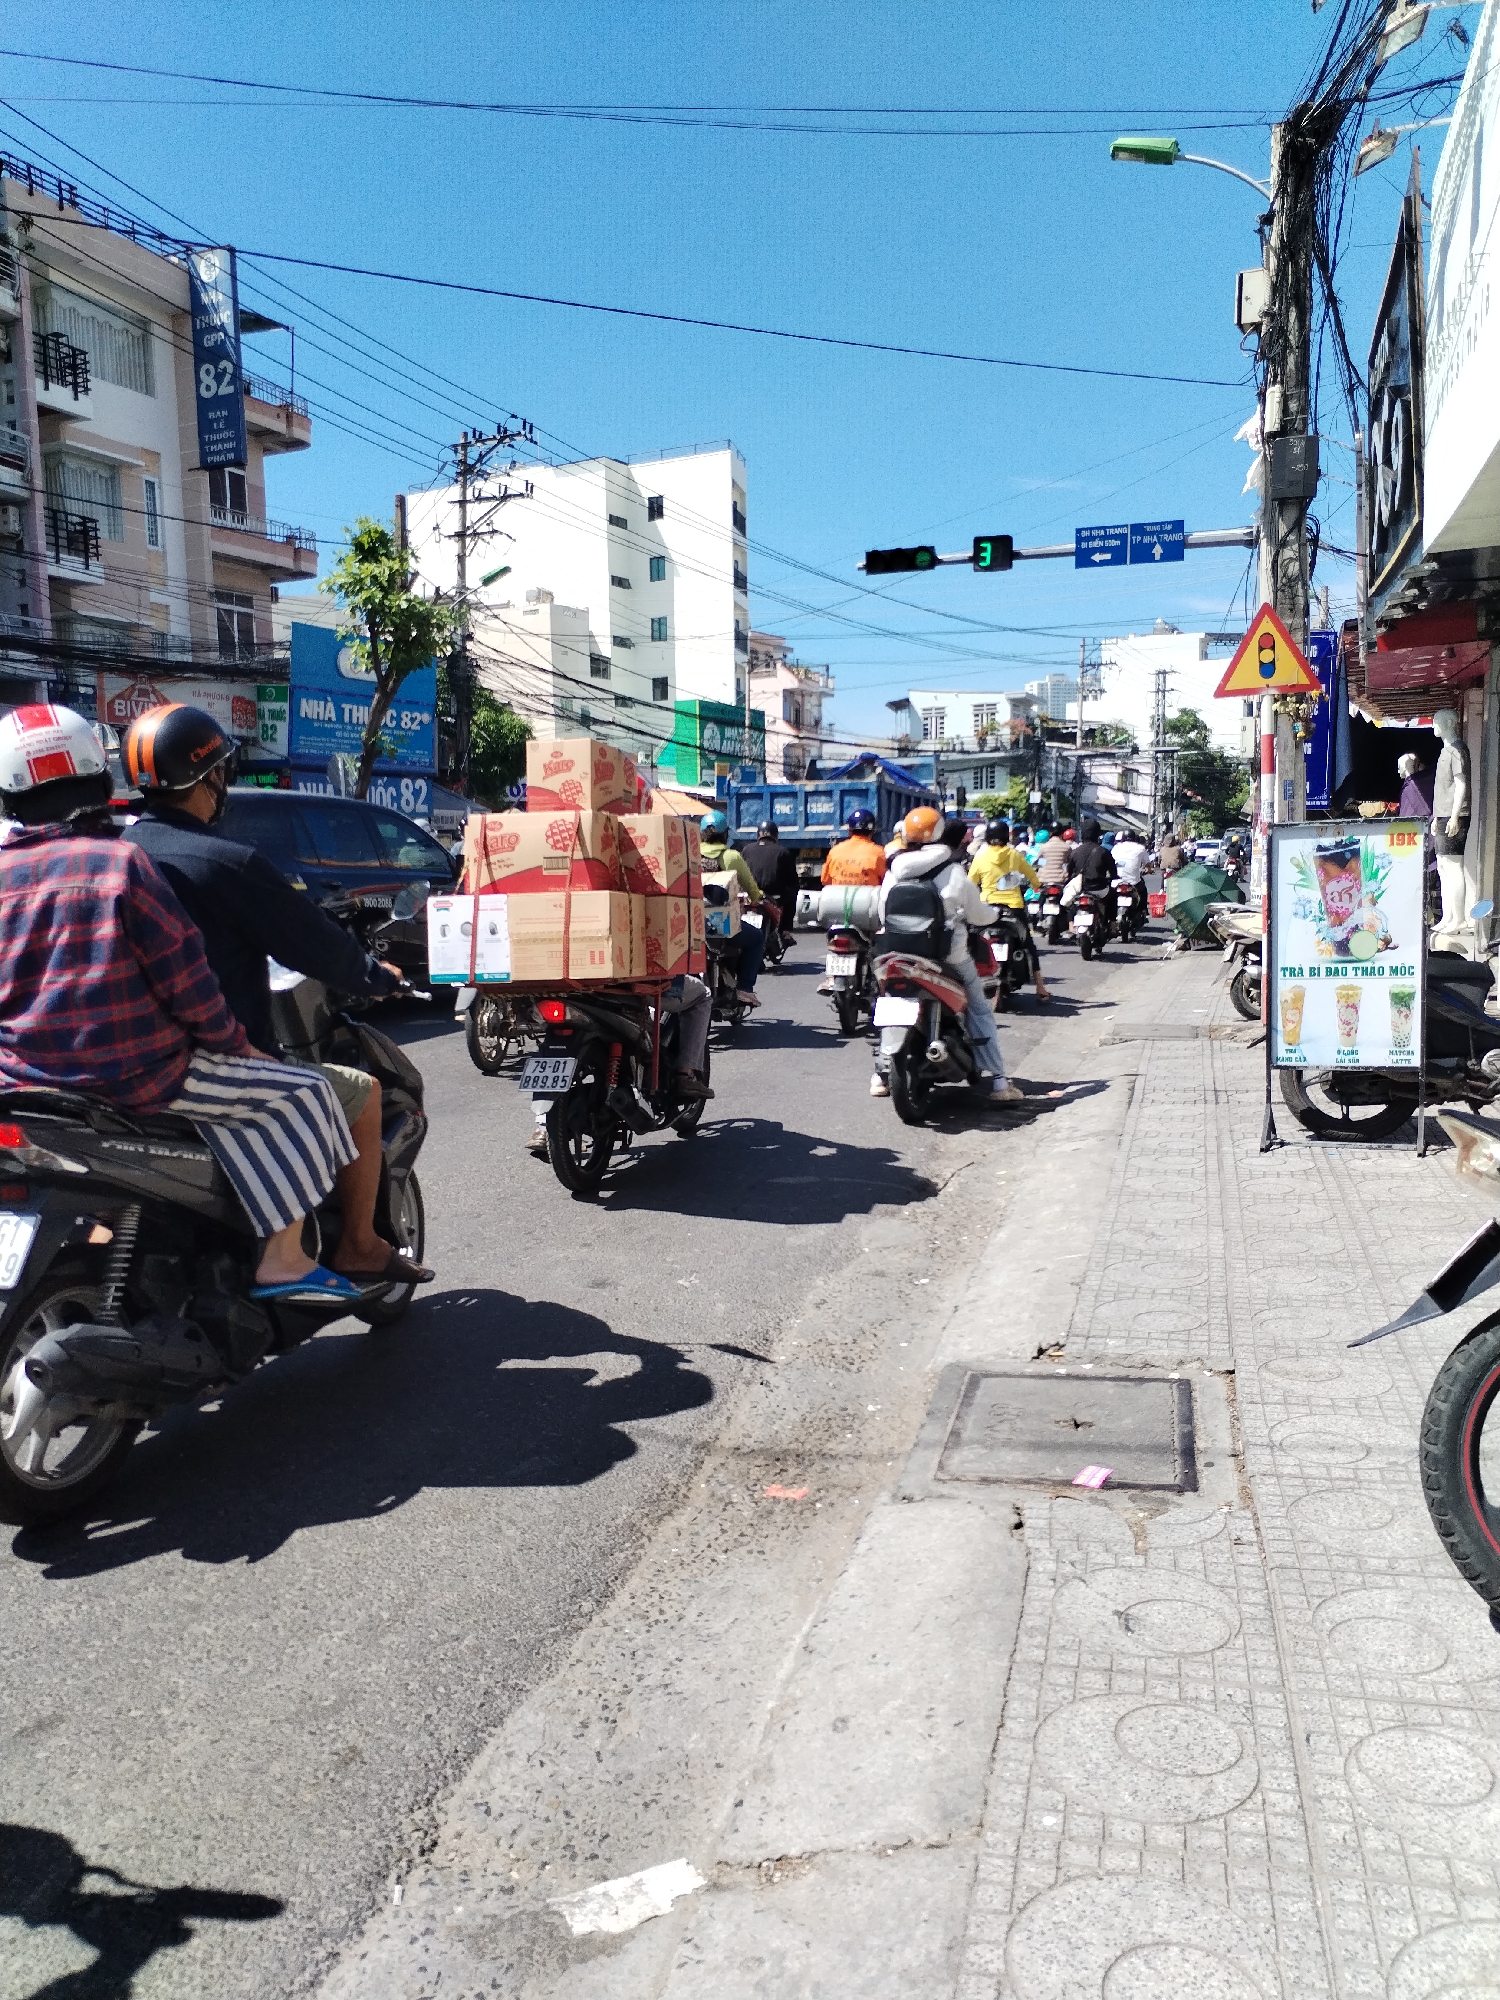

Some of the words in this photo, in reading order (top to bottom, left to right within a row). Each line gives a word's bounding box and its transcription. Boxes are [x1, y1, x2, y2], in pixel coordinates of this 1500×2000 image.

[203, 331, 225, 347] GPP
[200, 359, 235, 399] 82
[1106, 527, 1127, 535] TRANG
[1143, 524, 1160, 532] TRUNG
[1132, 536, 1141, 544] TP
[1159, 532, 1183, 543] TRANG
[979, 542, 992, 567] 3
[300, 696, 337, 721] NHÀ
[400, 710, 421, 730] 82
[261, 724, 278, 742] 82
[400, 777, 429, 813] 82
[1389, 832, 1418, 847] 19K
[1280, 963, 1304, 978] TRÀ
[1308, 963, 1321, 977] BÍ
[1352, 961, 1385, 977] THẢO
[1388, 1049, 1415, 1057] MATCHA
[522, 1075, 570, 1089] 889.85
